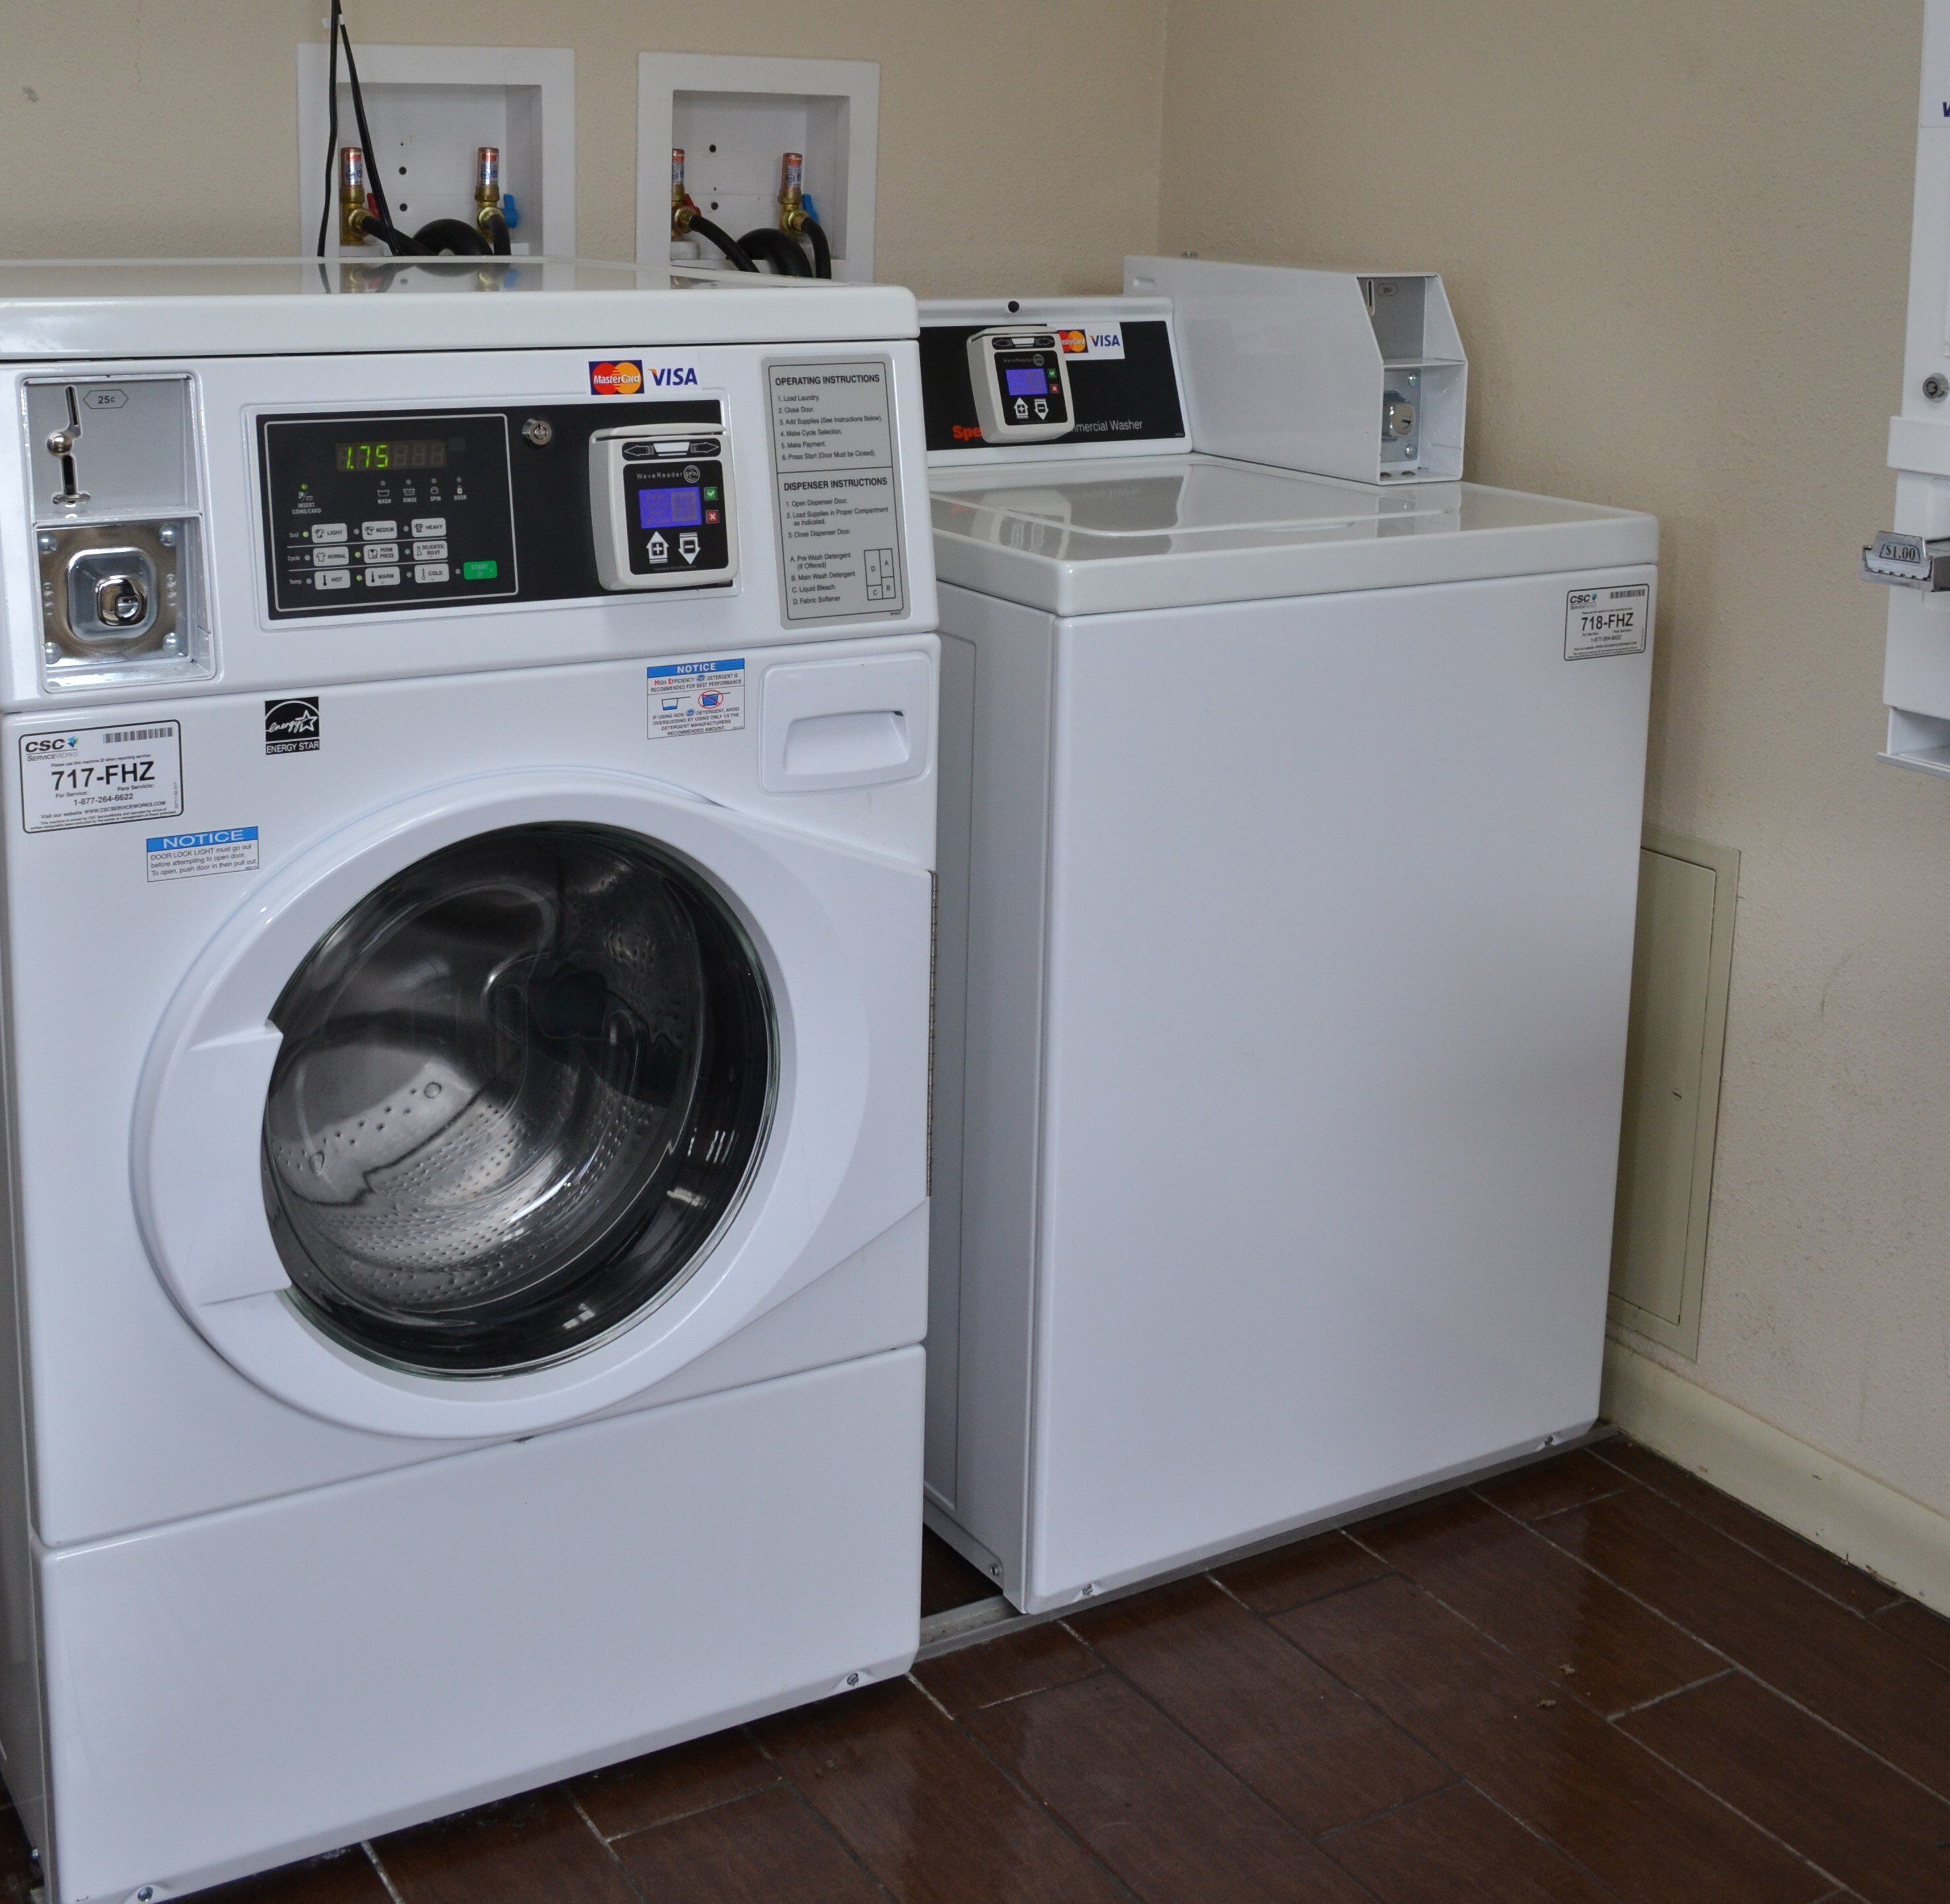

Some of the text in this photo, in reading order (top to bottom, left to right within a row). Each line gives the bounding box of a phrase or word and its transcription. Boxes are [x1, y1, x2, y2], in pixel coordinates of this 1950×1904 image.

[1090, 335, 1120, 346] VISA
[594, 368, 698, 386] MasterCard VISA
[776, 375, 879, 385] OPERATING INSTRUCTIONS
[953, 425, 981, 441] Spe
[1072, 420, 1142, 433] mercial Washer
[347, 445, 388, 469] 1.75
[784, 478, 887, 491] DISPENSER INSTRUCTIONS
[811, 529, 836, 538] Dispenser
[1885, 544, 1915, 560] $1.00
[1570, 595, 1590, 603] CSC
[1582, 612, 1633, 631] 718-FHZ
[677, 663, 716, 673] NOTICE
[26, 739, 65, 752] CSC
[267, 741, 319, 753] ENERGY STAR
[51, 761, 155, 790] 717-FHZ
[74, 793, 133, 806] 1-877-264-6622
[164, 830, 244, 849] NOTICE
[173, 857, 205, 866] attempting
